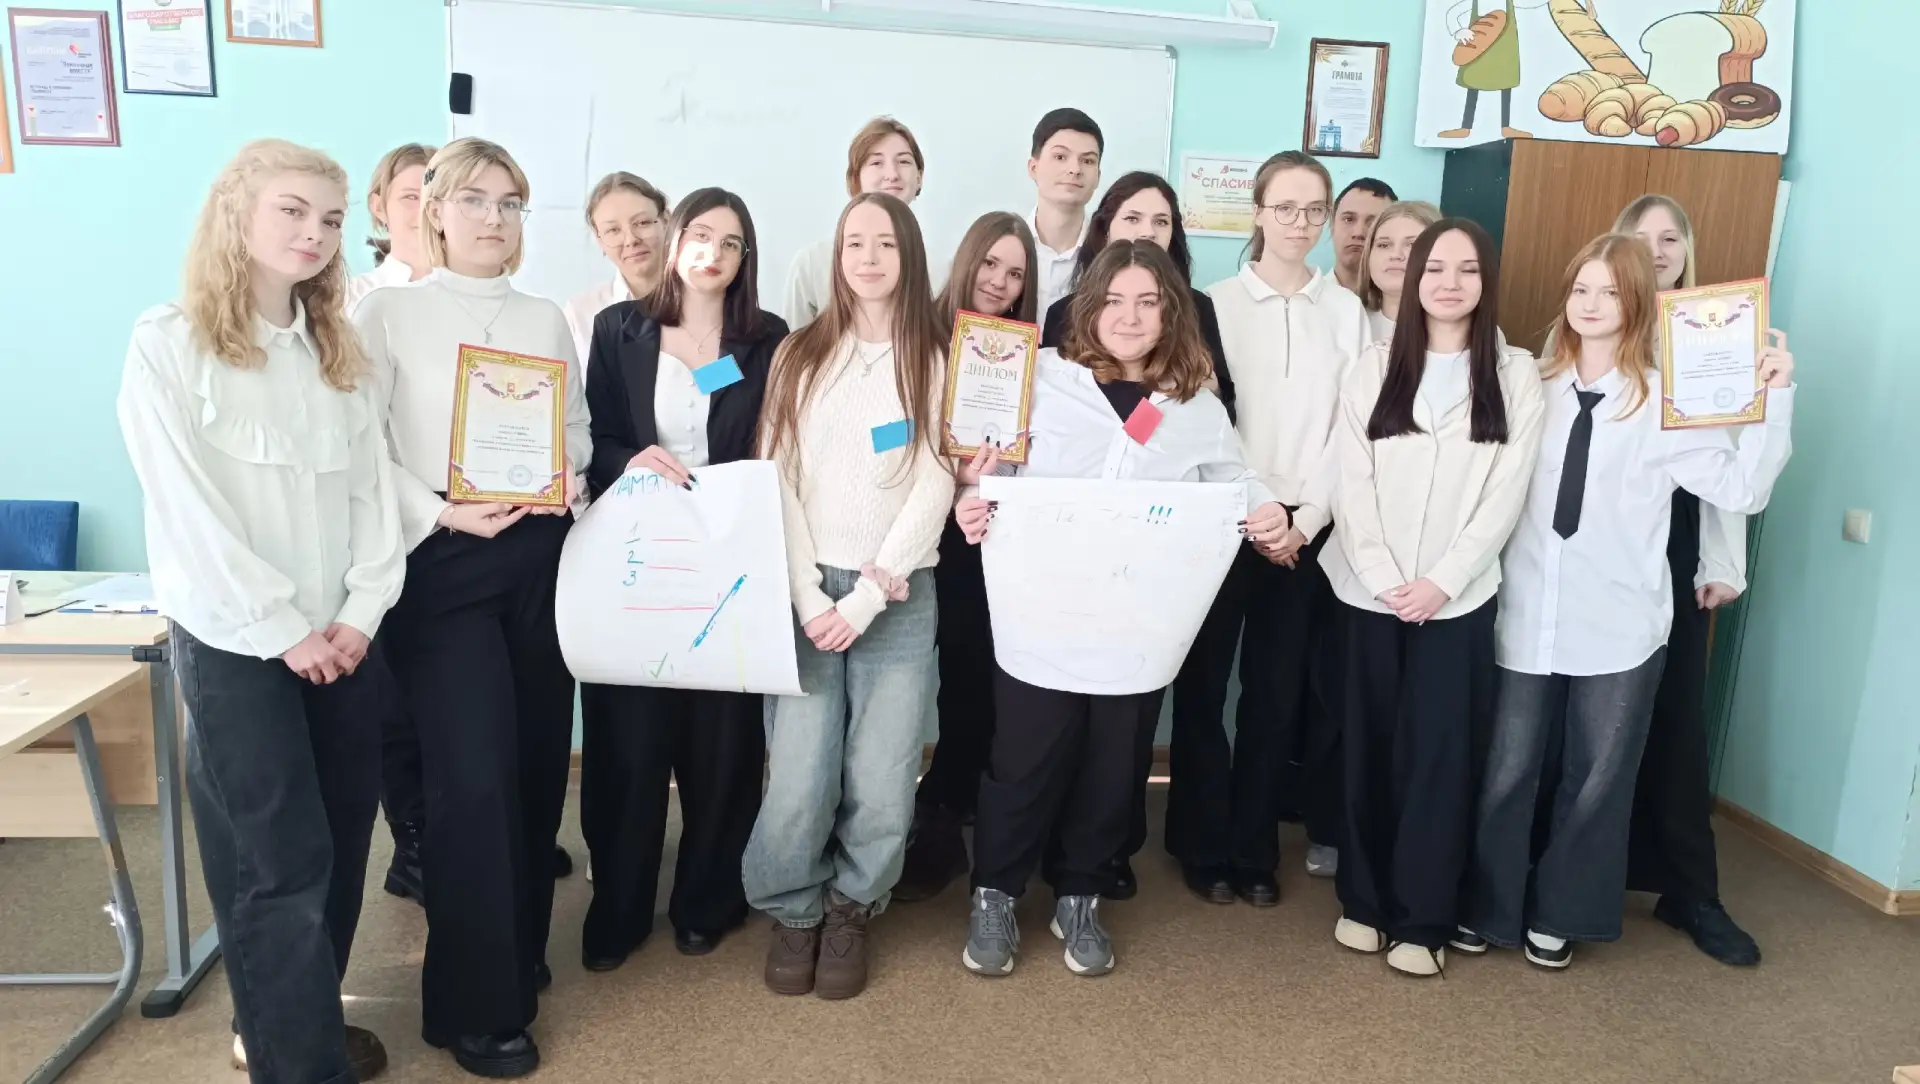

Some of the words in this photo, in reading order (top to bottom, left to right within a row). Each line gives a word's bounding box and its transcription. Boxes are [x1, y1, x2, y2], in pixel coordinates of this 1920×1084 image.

[1332, 71, 1362, 80] ГРАМОТА
[1201, 177, 1256, 189] СПАСИБ
[964, 363, 1017, 381] ДИПЛОМ
[627, 550, 644, 564] 2
[622, 570, 637, 587] 3
